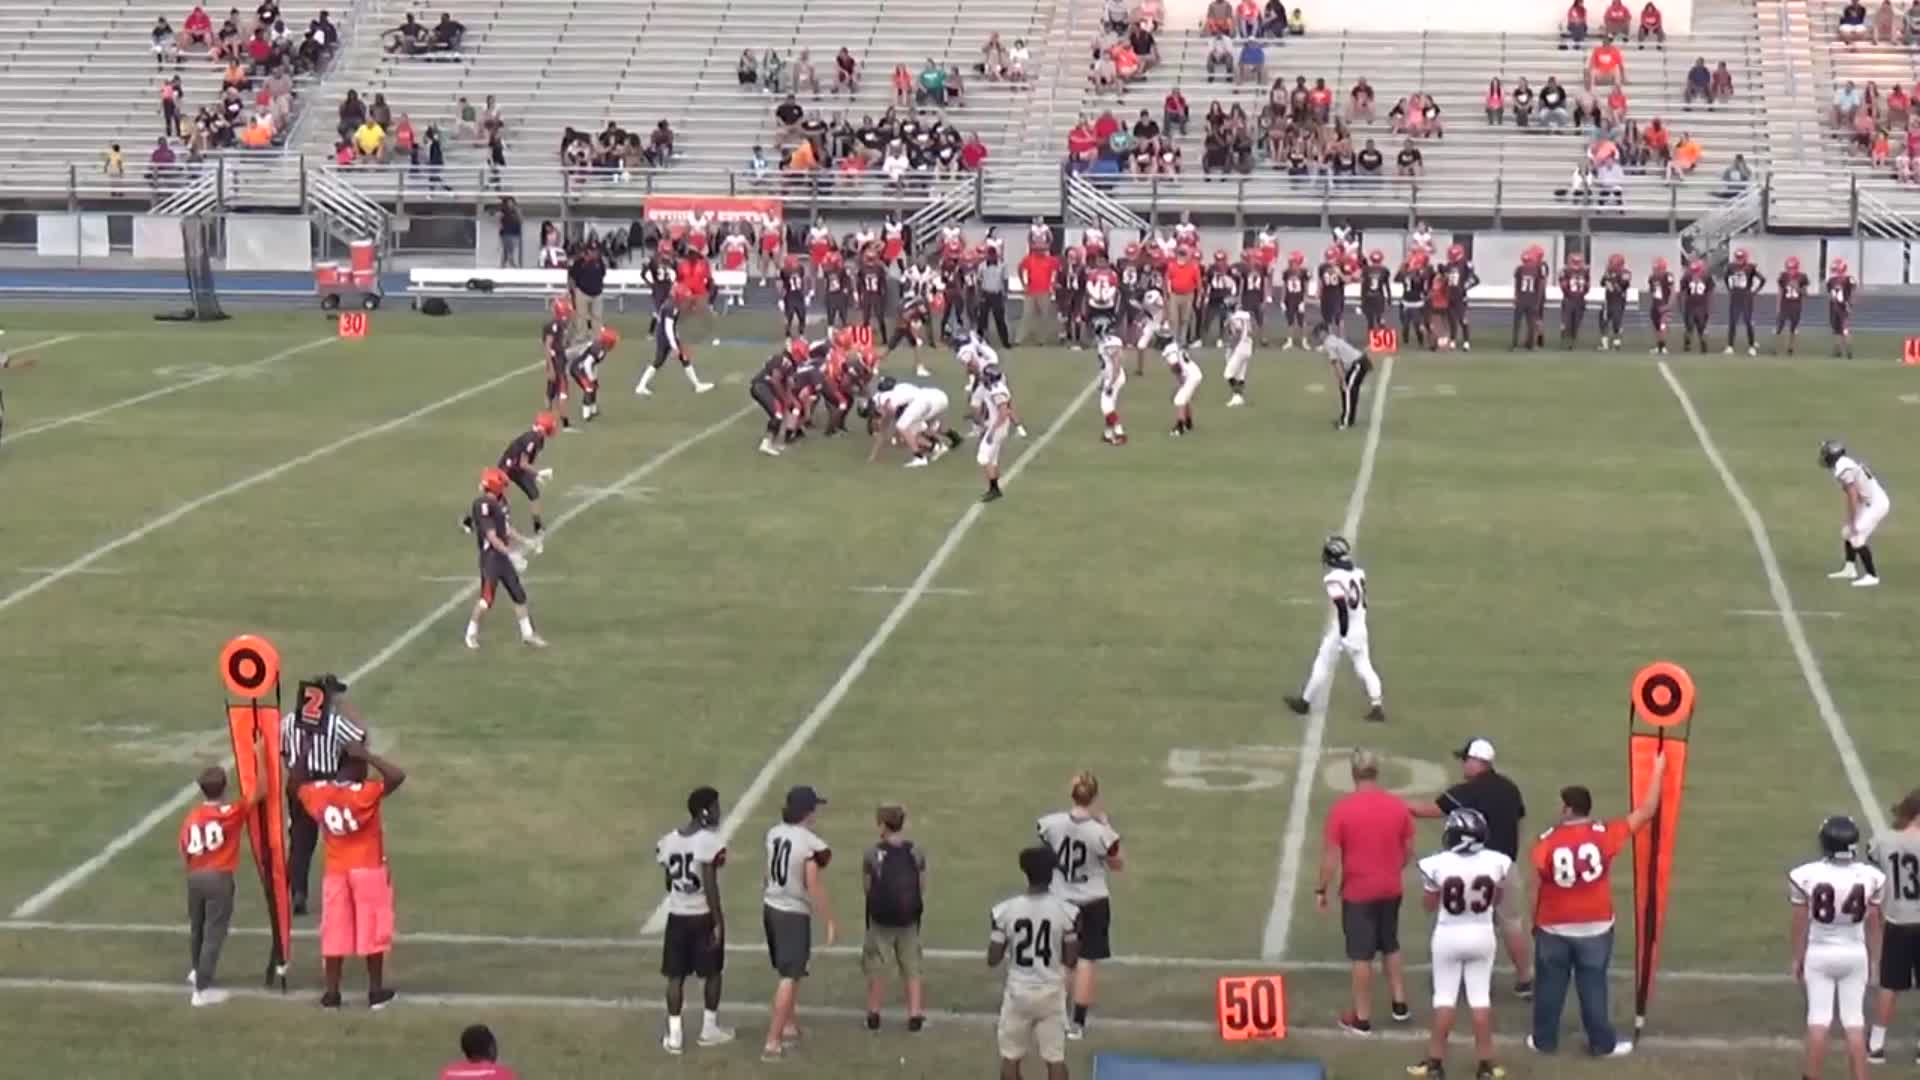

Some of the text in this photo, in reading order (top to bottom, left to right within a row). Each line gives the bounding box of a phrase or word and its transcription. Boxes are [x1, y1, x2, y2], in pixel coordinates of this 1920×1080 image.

[344, 312, 363, 333] 30
[1373, 333, 1394, 348] 50
[302, 686, 325, 720] 2
[669, 852, 701, 894] 25
[770, 836, 793, 887] 10
[1053, 836, 1089, 884] 42
[1551, 842, 1604, 889] 83
[1888, 850, 1920, 900] 13
[1442, 874, 1495, 916] 83
[1811, 882, 1867, 924] 84
[1013, 917, 1053, 968] 24
[1225, 979, 1277, 1031] 50
